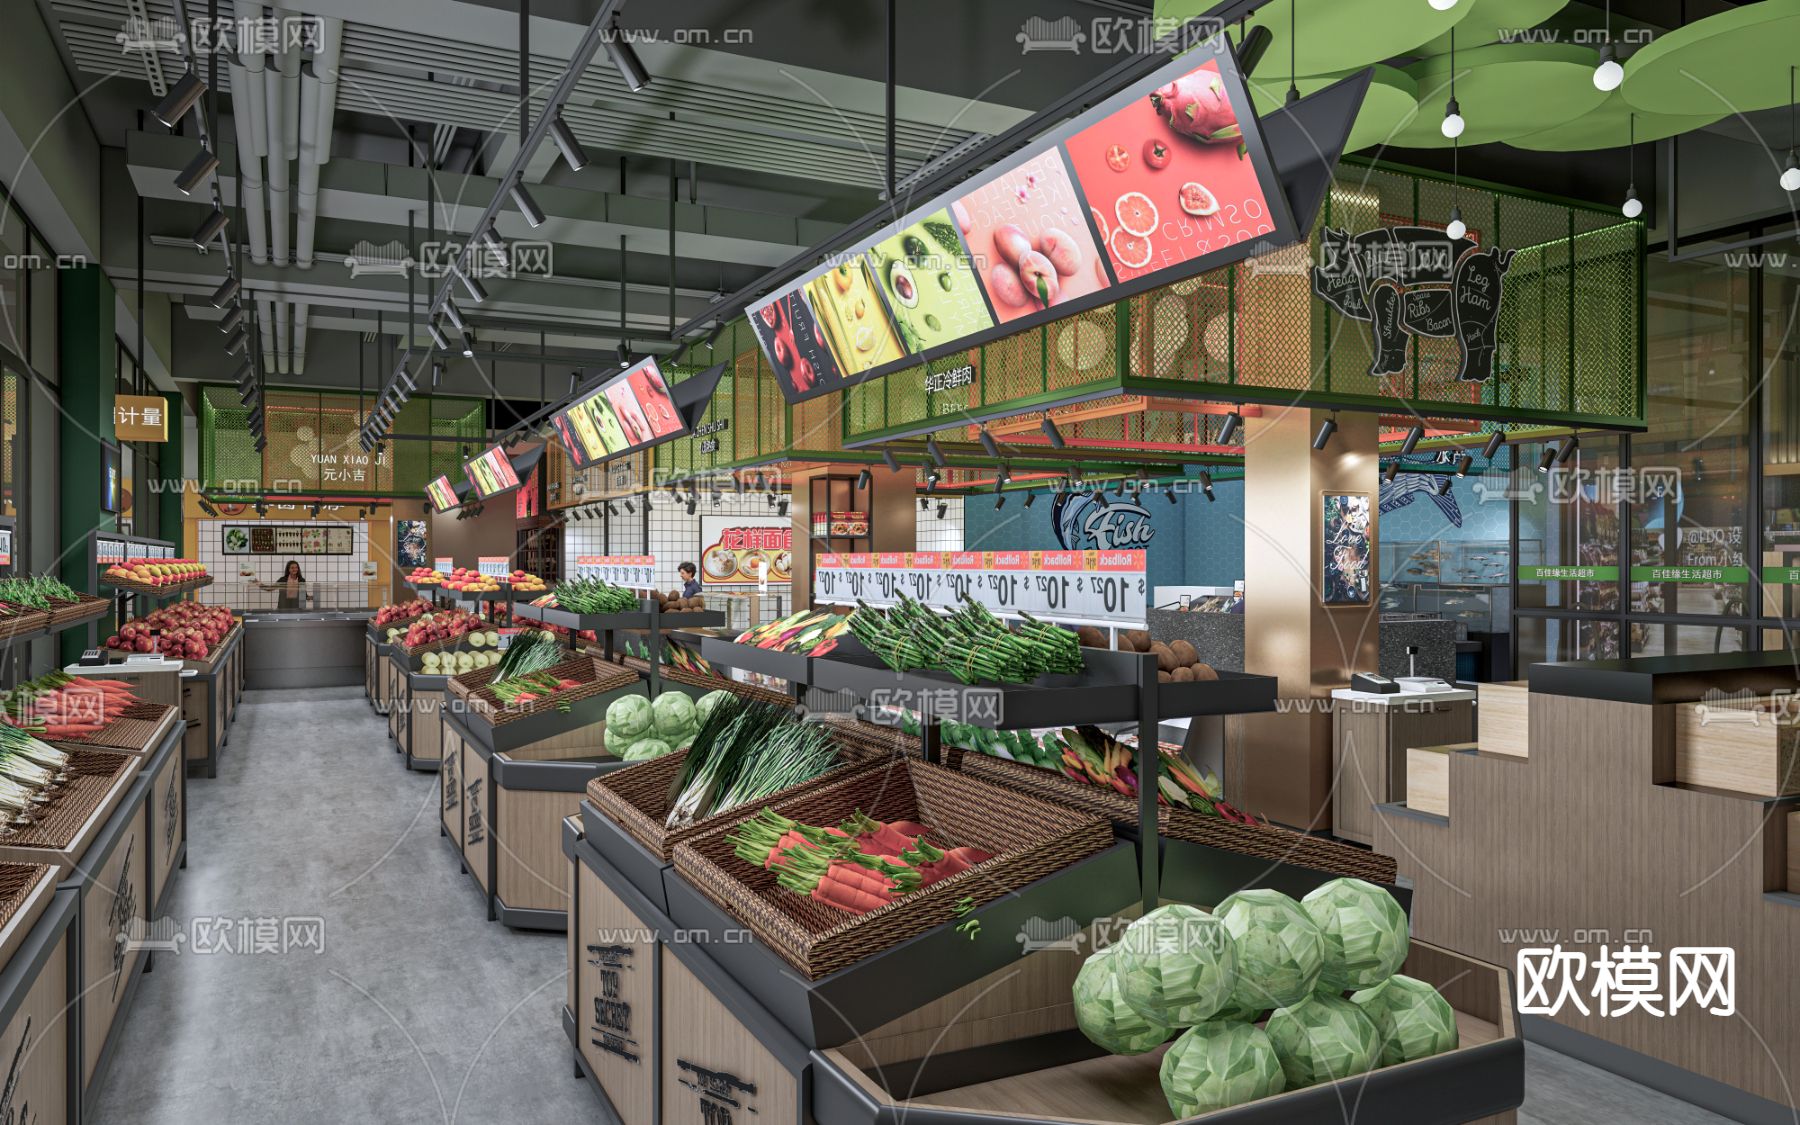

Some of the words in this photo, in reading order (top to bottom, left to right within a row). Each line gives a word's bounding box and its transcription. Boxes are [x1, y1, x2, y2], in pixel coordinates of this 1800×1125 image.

[1459, 286, 1491, 311] Ham
[1408, 299, 1431, 319] Ribs
[1425, 316, 1452, 332] Bacon
[925, 366, 972, 395] 华正冷鲜肉
[113, 406, 162, 426] 计量
[311, 454, 338, 464] YUAN
[343, 454, 369, 464] XIAO
[323, 468, 366, 482] 元小吉
[1326, 518, 1362, 545] Love
[1535, 567, 1595, 579] 百佳缘生活超市
[1652, 568, 1723, 580] 百佳缘生活超市
